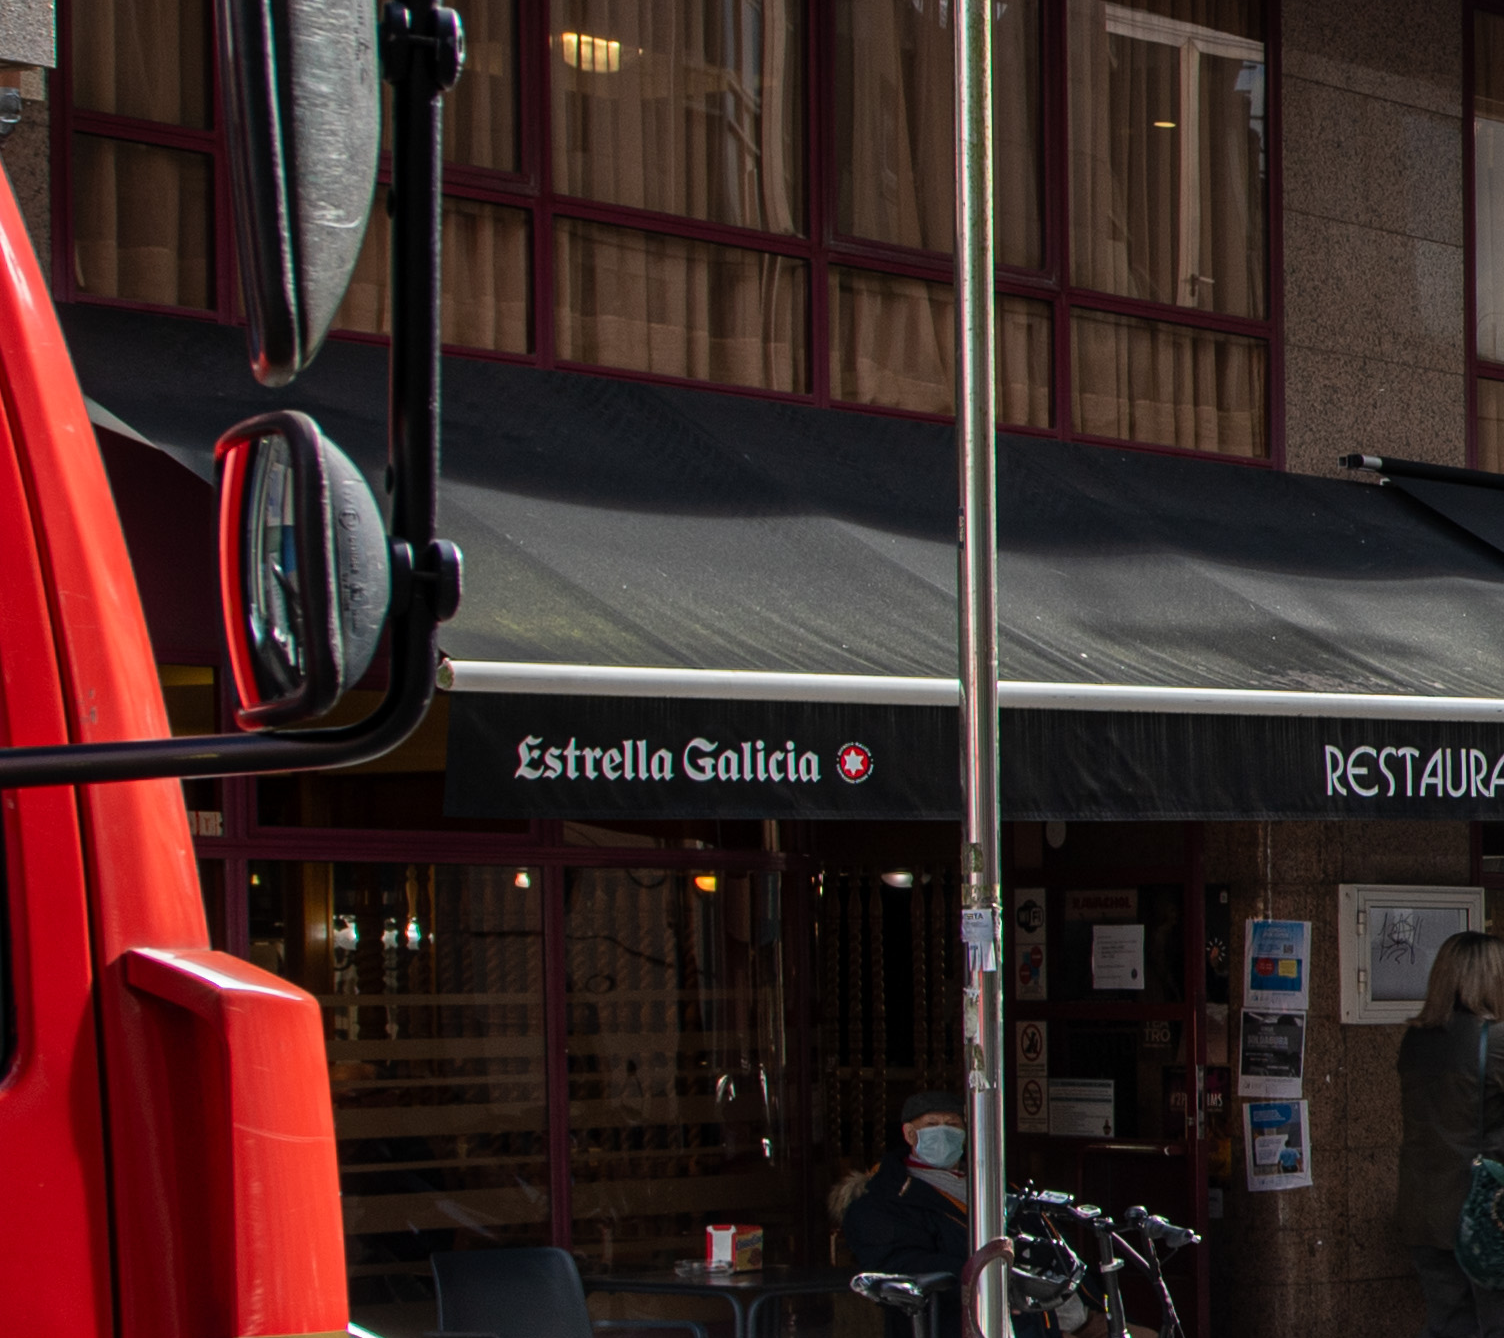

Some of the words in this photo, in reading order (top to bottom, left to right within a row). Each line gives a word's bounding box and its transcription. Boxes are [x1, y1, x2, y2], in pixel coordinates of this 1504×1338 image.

[514, 734, 675, 782] Estrella
[682, 736, 822, 783] Galicia
[1143, 1028, 1171, 1042] TRO
